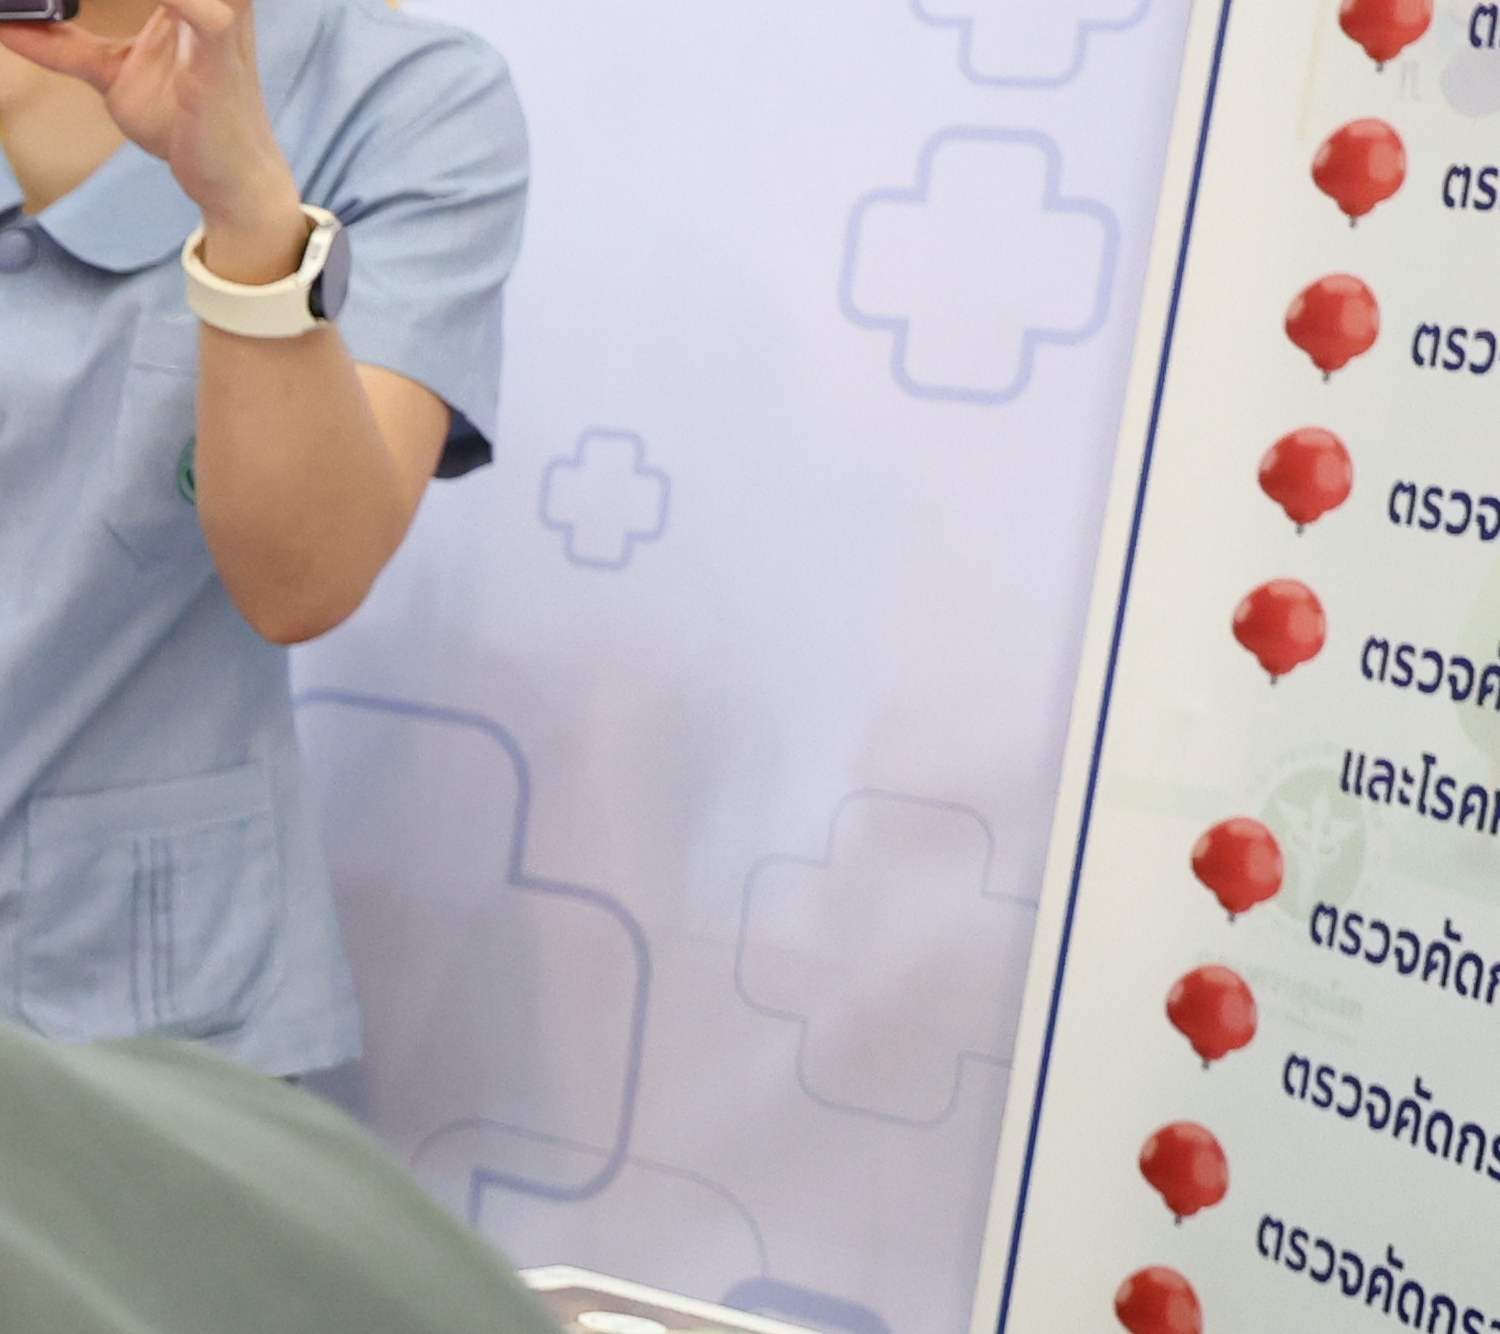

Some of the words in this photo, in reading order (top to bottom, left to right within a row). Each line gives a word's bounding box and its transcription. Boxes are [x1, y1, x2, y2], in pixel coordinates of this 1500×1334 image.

[1442, 164, 1500, 211] ตร
[1412, 322, 1500, 375] ตรว
[1340, 749, 1500, 835] และโรค
